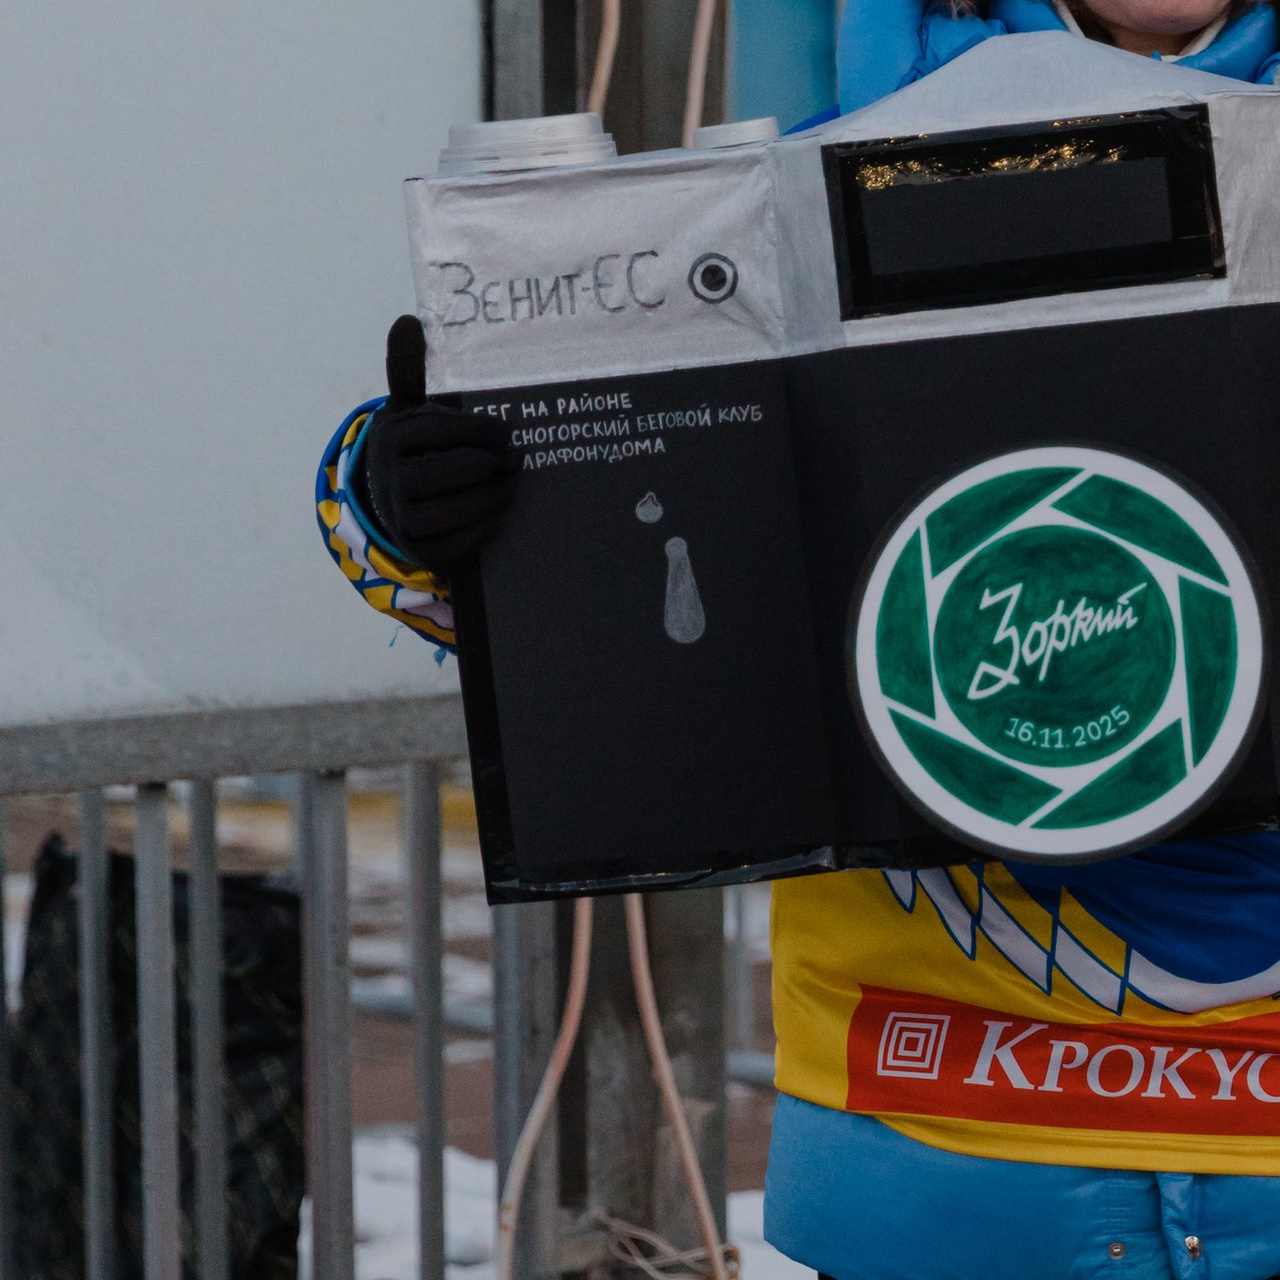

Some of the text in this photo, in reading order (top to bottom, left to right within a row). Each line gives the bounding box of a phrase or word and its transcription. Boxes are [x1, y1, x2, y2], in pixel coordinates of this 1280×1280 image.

[509, 402, 764, 447] СНОГОРСКИЙ БЕГОВОЙ КЛУБ
[521, 400, 549, 419] НА
[556, 392, 633, 416] РАЙОНЕ
[522, 436, 667, 470] АРАФОНУДОМА
[966, 581, 1148, 701] Зоркий
[1003, 703, 1131, 749] 16.11.2025
